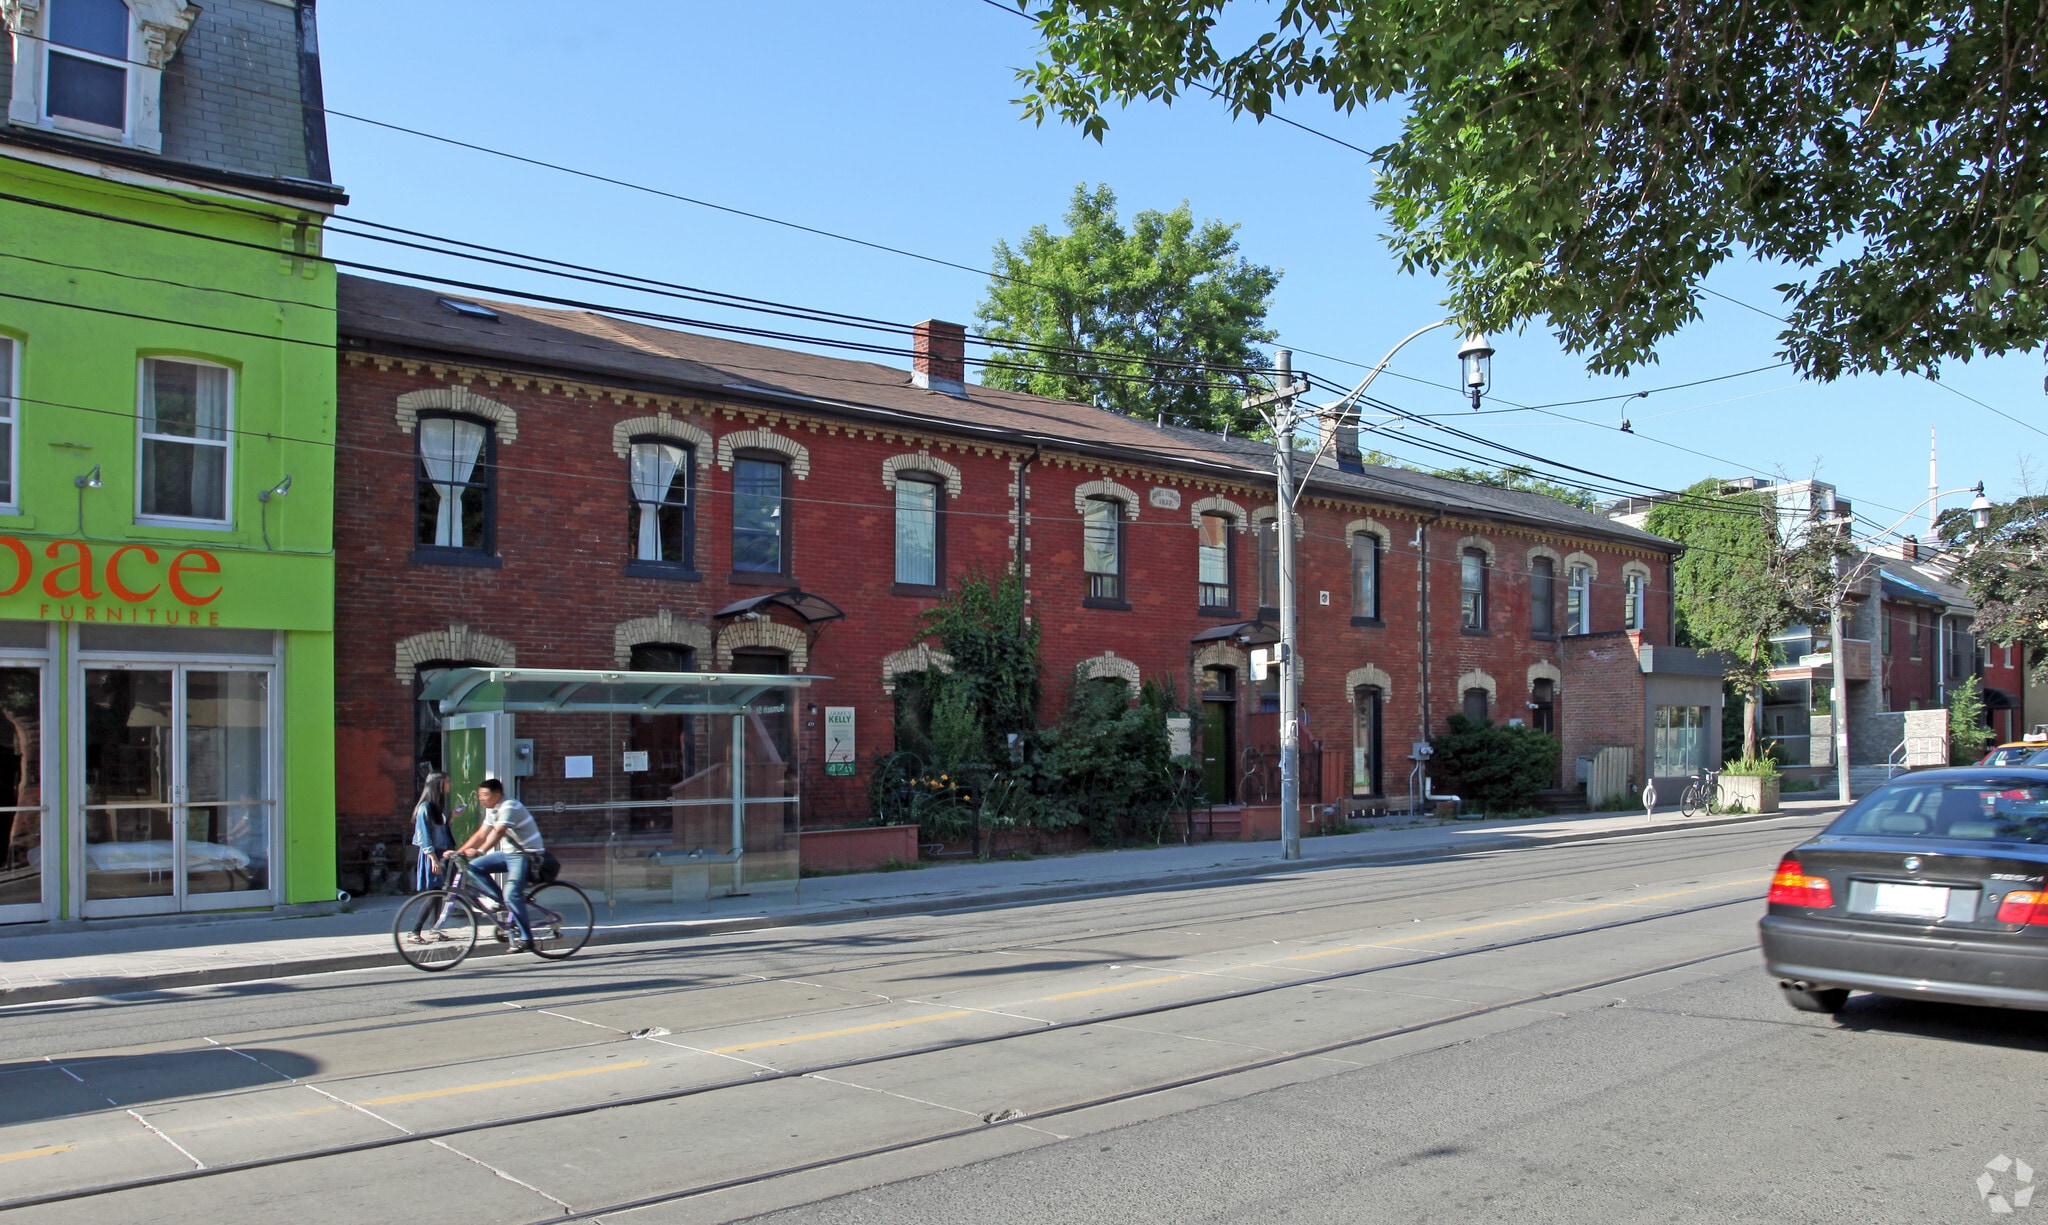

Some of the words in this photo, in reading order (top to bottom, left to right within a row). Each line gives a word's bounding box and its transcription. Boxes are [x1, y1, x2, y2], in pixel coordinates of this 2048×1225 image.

[40, 604, 219, 626] FURNITURE
[828, 715, 852, 724] KELLY
[829, 763, 852, 773] 475
